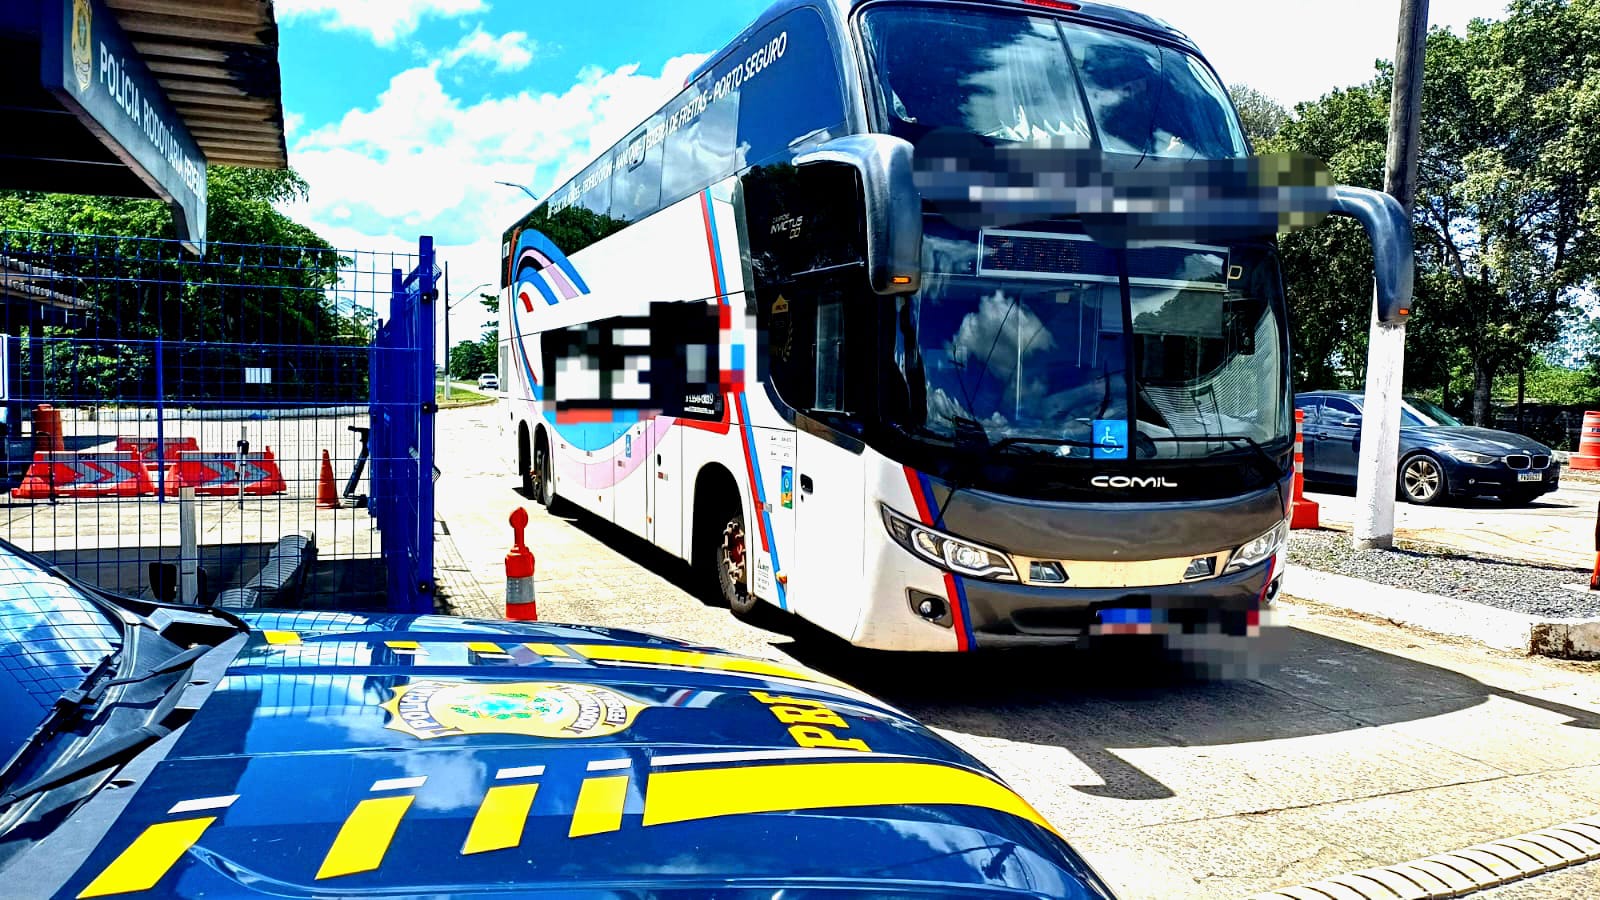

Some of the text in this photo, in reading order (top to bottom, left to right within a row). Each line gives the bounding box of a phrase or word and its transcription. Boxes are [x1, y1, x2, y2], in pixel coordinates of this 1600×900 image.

[100, 41, 141, 126] POLÍCIA
[143, 97, 183, 178] RODOVIÁRIA
[668, 111, 679, 136] DE
[679, 90, 708, 128] FREITAS
[713, 64, 743, 103] PORTO
[744, 31, 787, 82] SEGURO
[1091, 476, 1178, 487] COMIL
[748, 691, 872, 752] PRF
